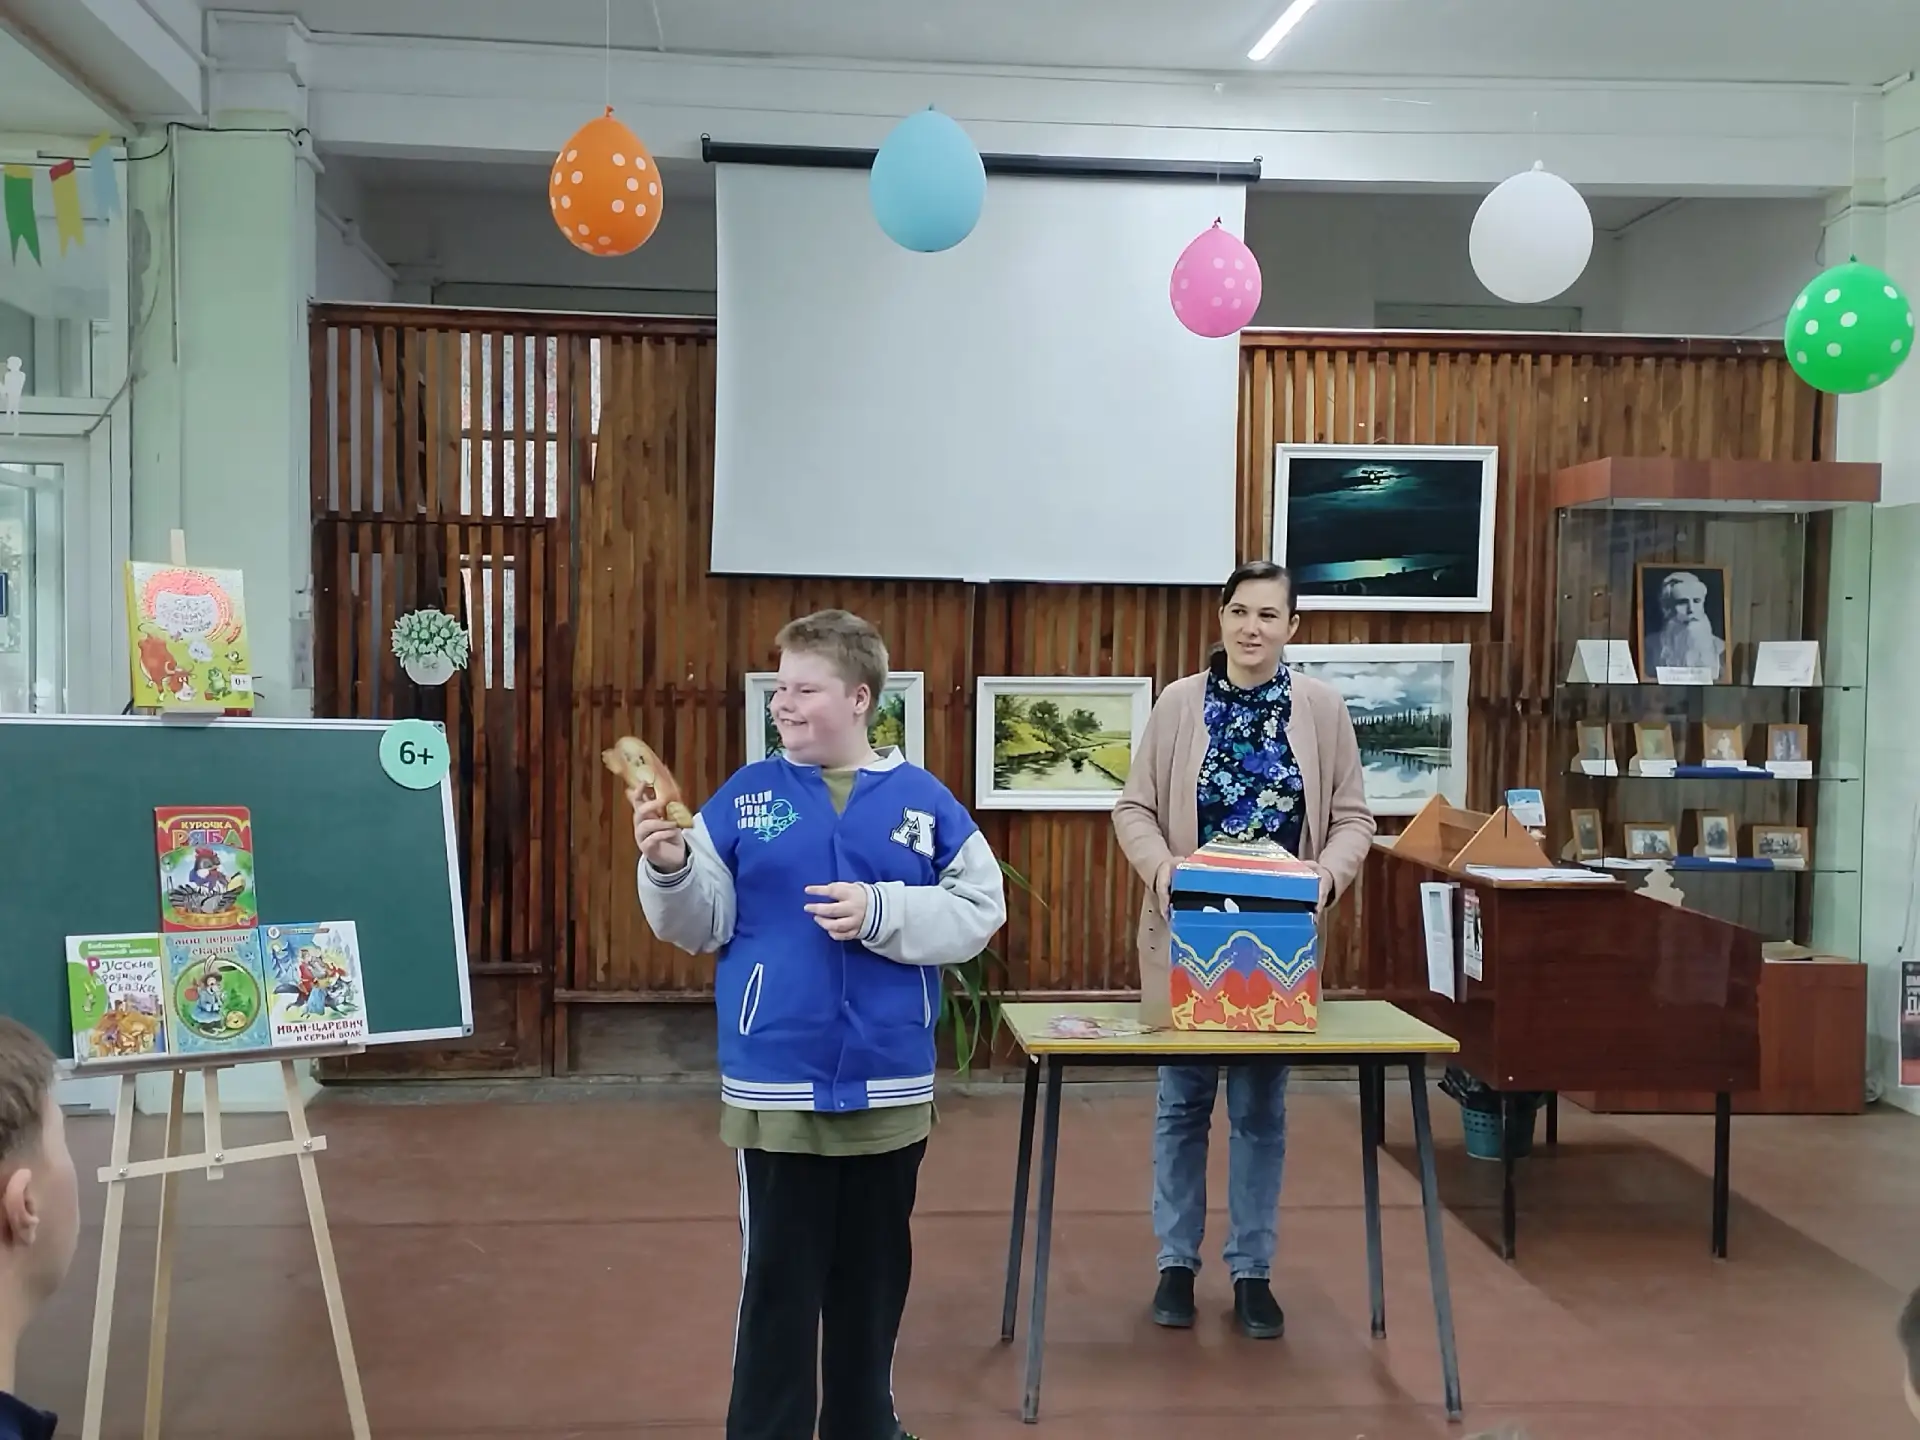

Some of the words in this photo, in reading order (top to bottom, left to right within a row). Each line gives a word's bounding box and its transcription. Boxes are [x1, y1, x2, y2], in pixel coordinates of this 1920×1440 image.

[400, 741, 434, 765] 6+
[734, 789, 772, 809] FOLLOW
[181, 820, 233, 830] КУРОЧКА
[890, 806, 936, 860] A
[171, 829, 244, 849] РЯБА
[277, 1019, 363, 1035] ИВАН-ЦАРЕВИЧ
